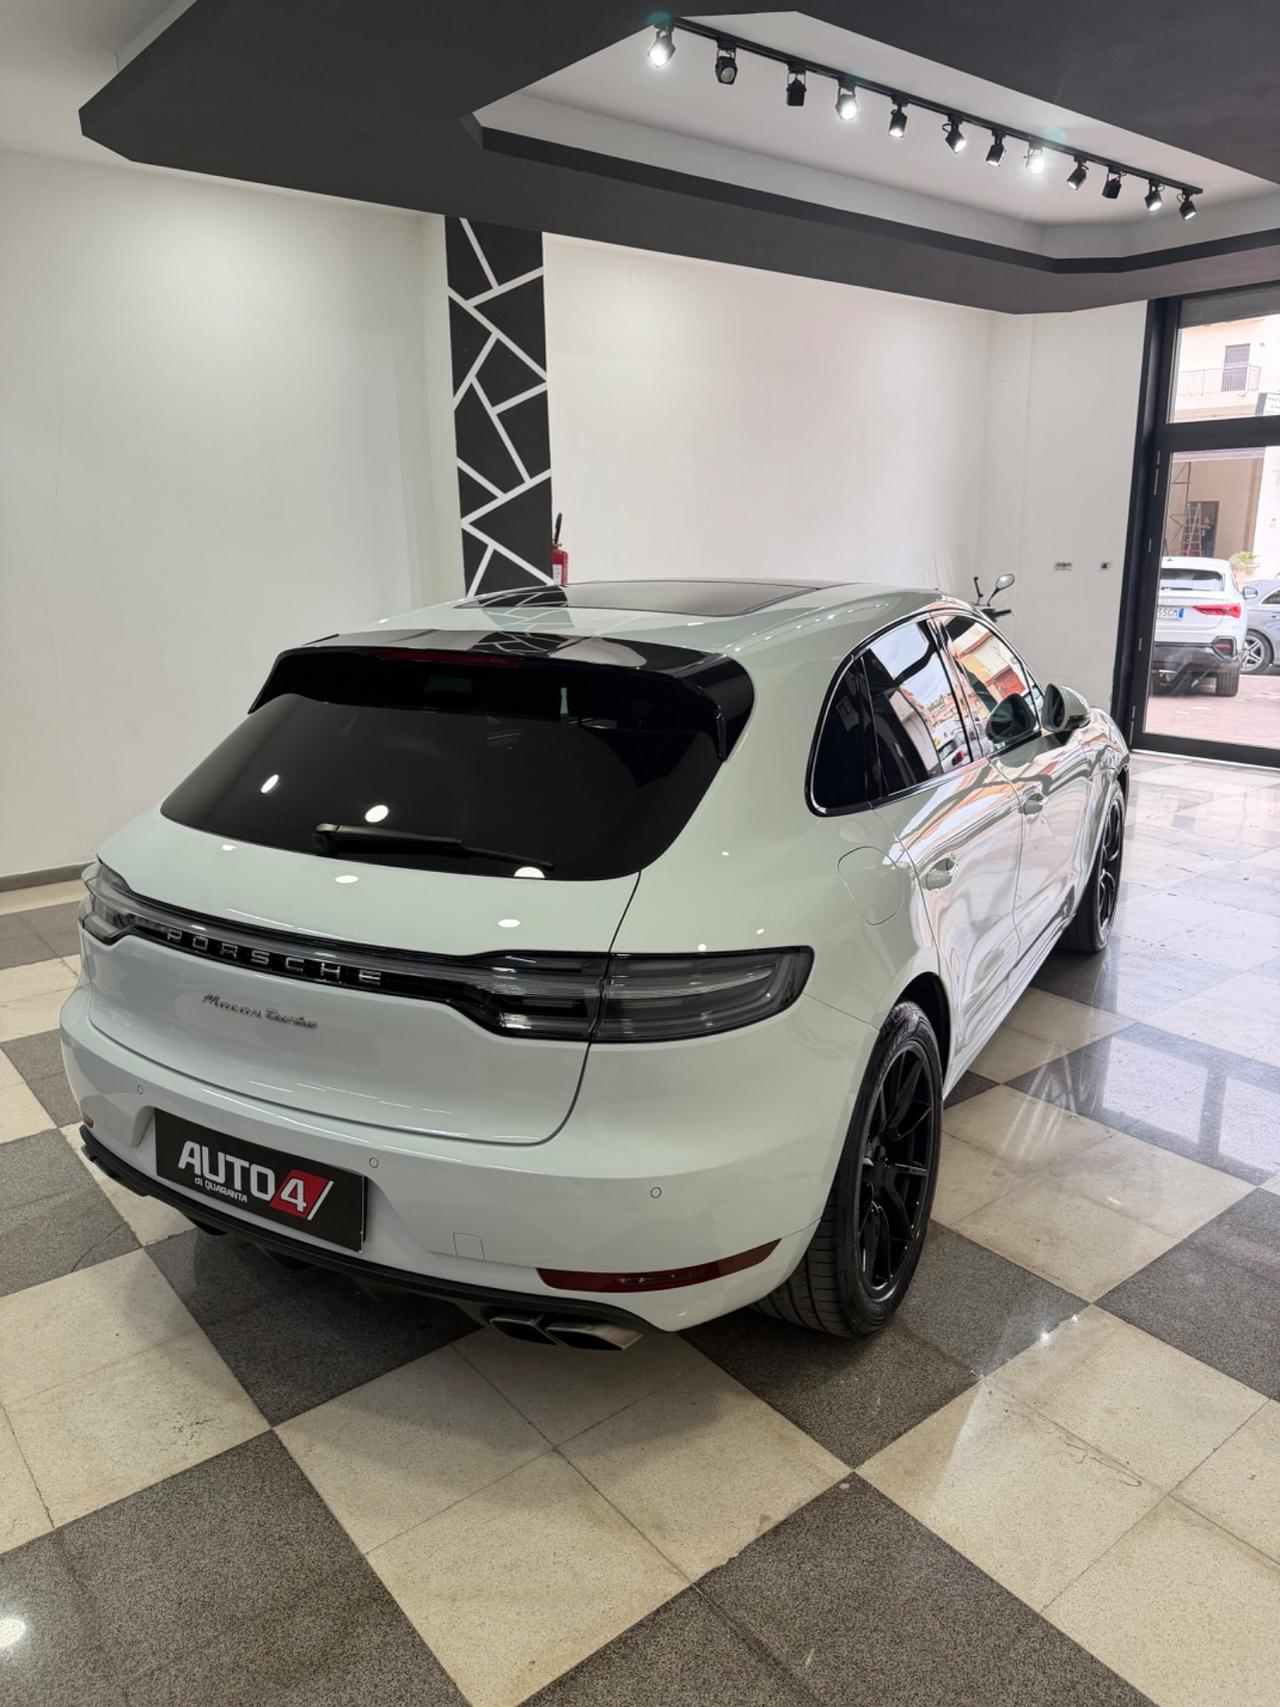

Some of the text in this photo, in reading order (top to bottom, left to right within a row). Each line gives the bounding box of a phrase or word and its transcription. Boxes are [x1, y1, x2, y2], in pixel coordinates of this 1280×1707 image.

[167, 929, 381, 986] PORSCHE
[202, 993, 261, 1018] Macan
[204, 1180, 248, 1203] QUARANTA
